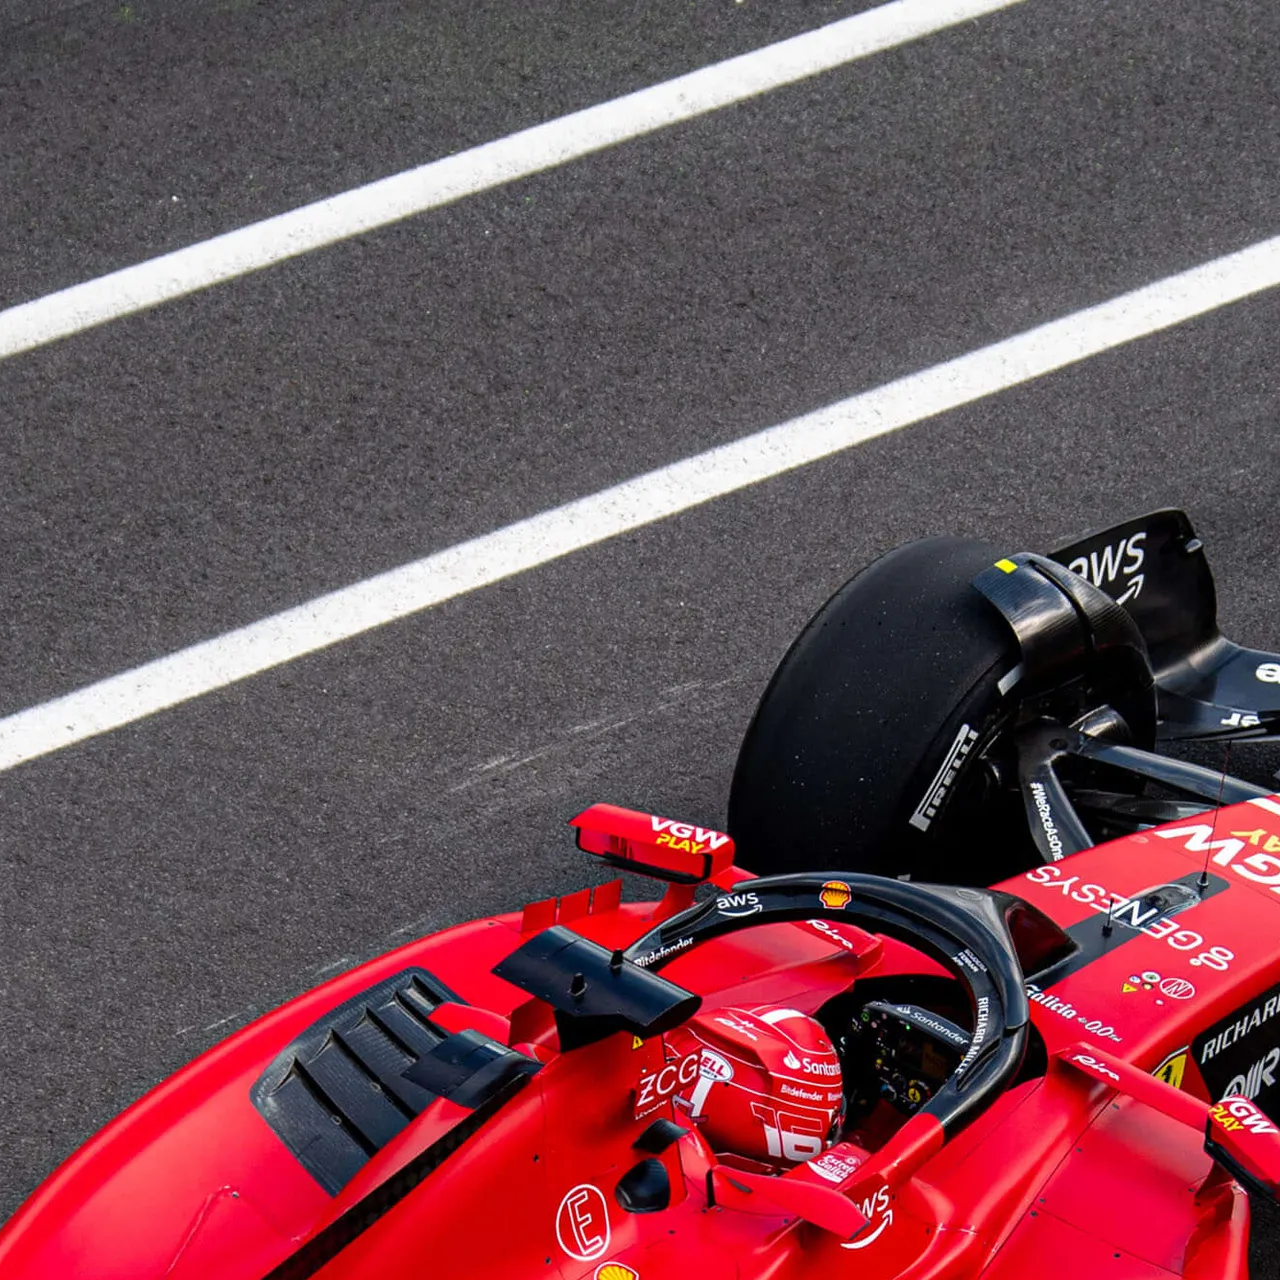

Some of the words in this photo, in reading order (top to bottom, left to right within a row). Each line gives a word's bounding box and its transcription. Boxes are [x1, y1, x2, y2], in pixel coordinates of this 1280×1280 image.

[650, 815, 731, 850] VGW
[656, 833, 704, 854] PLAY
[716, 892, 760, 910] aws
[1026, 866, 1203, 950] GENESYS
[633, 937, 694, 968] Bitdefender
[910, 1012, 969, 1045] Santander
[972, 997, 989, 1043] RICHARD
[700, 1056, 726, 1078] ELL
[1072, 1055, 1120, 1081] Riva
[750, 1101, 823, 1162] 16
[1208, 1104, 1245, 1132] PLAY
[856, 1185, 890, 1218] ws
[567, 1190, 604, 1255] E
